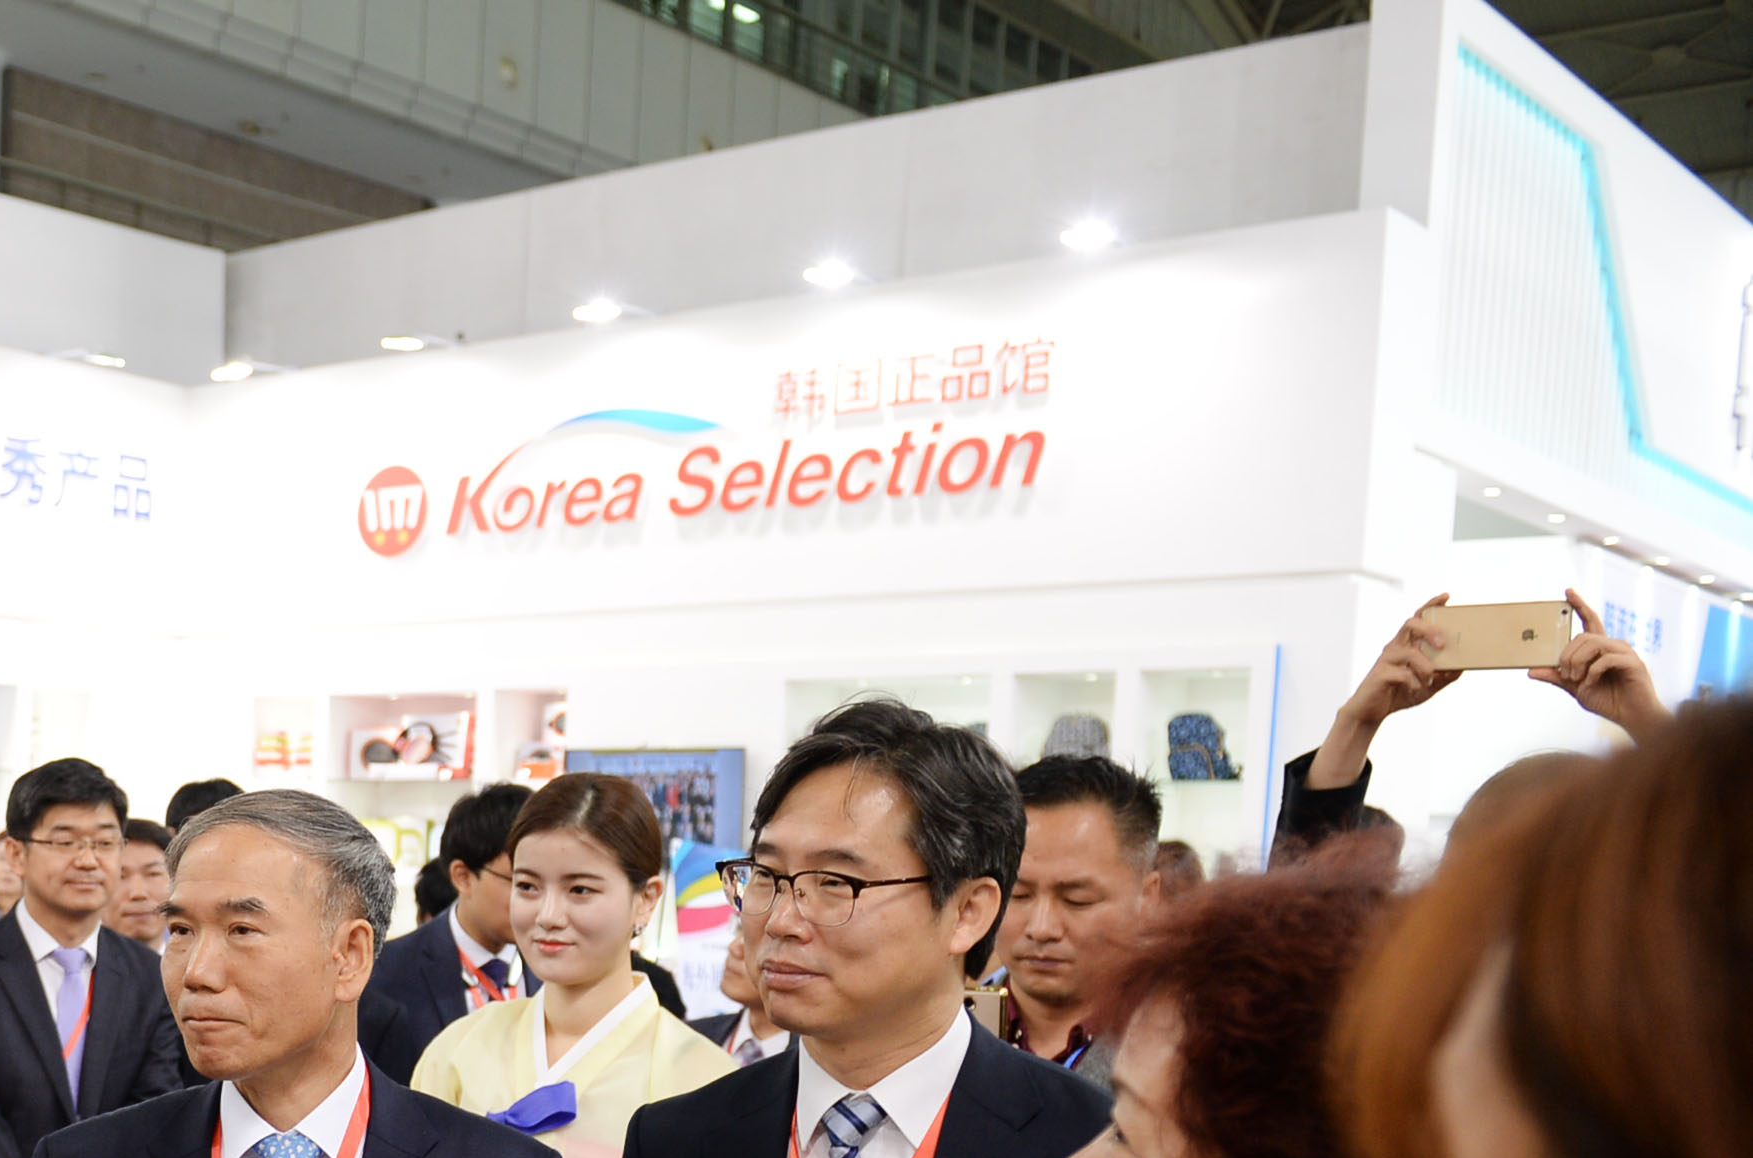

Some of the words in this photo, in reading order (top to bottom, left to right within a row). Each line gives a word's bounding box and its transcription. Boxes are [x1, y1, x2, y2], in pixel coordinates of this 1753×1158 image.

[773, 338, 1056, 420] 韩国正品馆
[446, 440, 644, 536] Korea
[668, 423, 1047, 516] Selection
